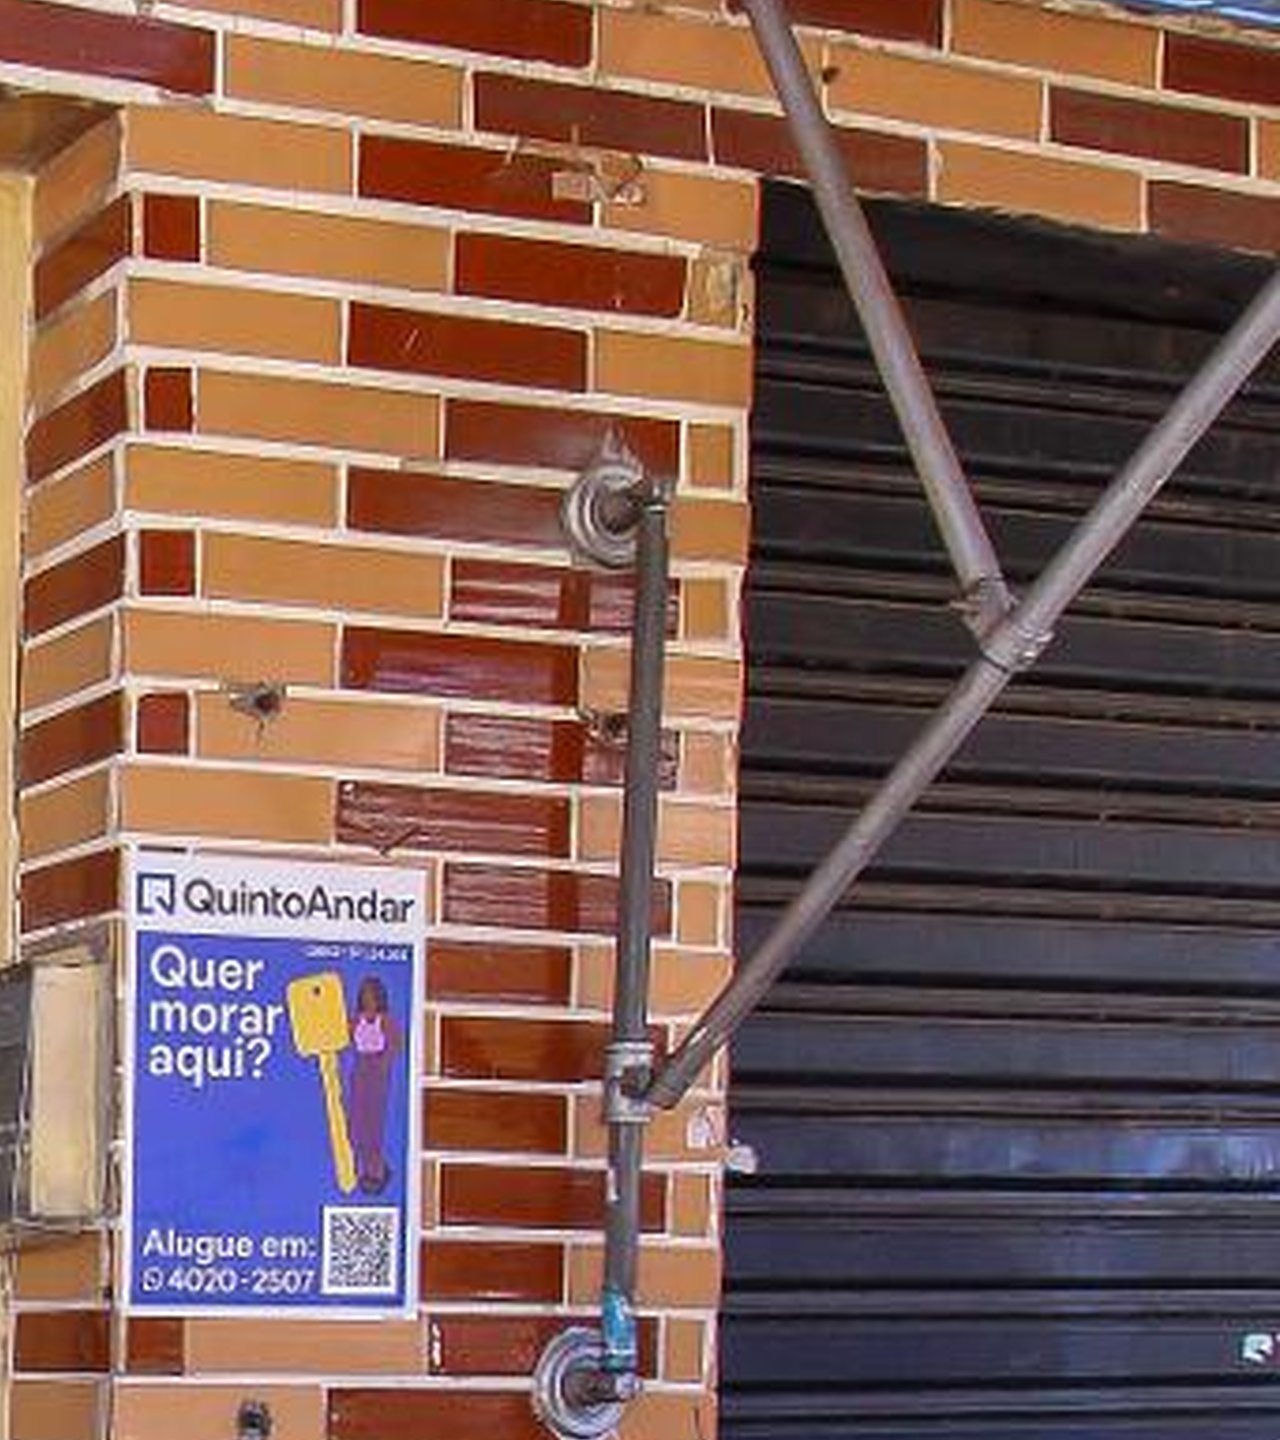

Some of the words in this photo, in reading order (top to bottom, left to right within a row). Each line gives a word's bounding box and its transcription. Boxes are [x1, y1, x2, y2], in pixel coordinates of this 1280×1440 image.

[183, 878, 416, 924] QuintoAndar
[150, 944, 265, 991] Quer
[149, 999, 284, 1036] morar
[149, 1038, 272, 1088] aqui?
[142, 1228, 253, 1265] Alugue
[261, 1235, 317, 1259] em:
